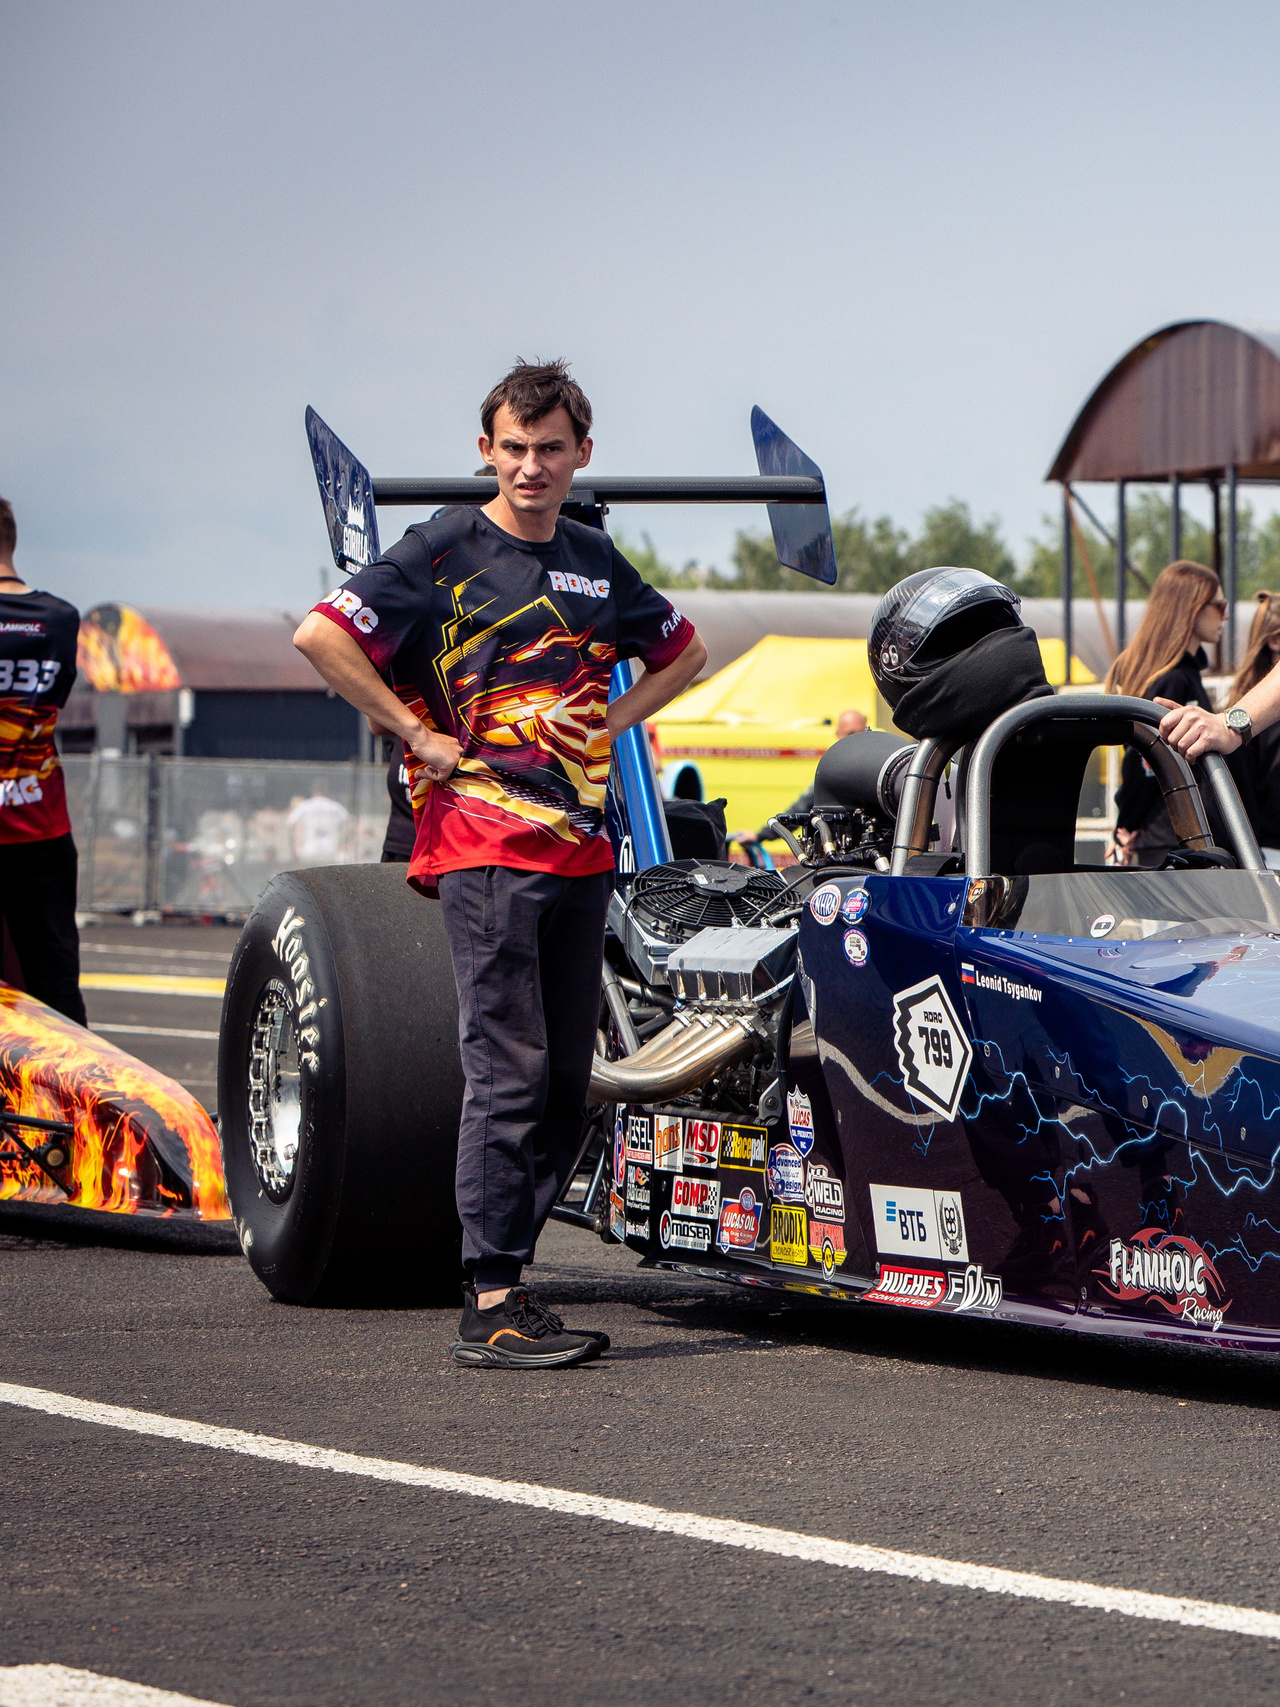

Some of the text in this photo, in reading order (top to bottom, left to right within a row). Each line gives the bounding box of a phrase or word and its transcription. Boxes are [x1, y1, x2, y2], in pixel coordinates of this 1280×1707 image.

[343, 526, 368, 566] GORILLA
[547, 570, 611, 599] RDRC
[814, 893, 836, 916] NHRA
[269, 979, 295, 1012] WELD
[976, 970, 1043, 1002] Leonid Tsygankov
[923, 1011, 943, 1023] RDRC
[918, 1026, 953, 1069] 799
[627, 1115, 653, 1151] JESEL
[792, 1109, 810, 1128] LUCAS
[655, 1117, 681, 1167] hans
[685, 1121, 719, 1152] MSD
[732, 1130, 765, 1166] Racepak
[674, 1180, 709, 1207] COMP
[814, 1181, 842, 1206] WELD
[697, 1204, 715, 1215] CAMS
[722, 1211, 756, 1232] LUCAS OIL
[815, 1206, 843, 1217] RACING
[671, 1222, 711, 1240] MOSER
[773, 1209, 805, 1246] BRODIX
[898, 1209, 927, 1242] ВТБ
[1109, 1237, 1208, 1297] FLAMHOLC
[868, 1292, 934, 1307] CONVERTERS
[876, 1270, 944, 1299] HUGHES
[1179, 1296, 1224, 1332] Racing
